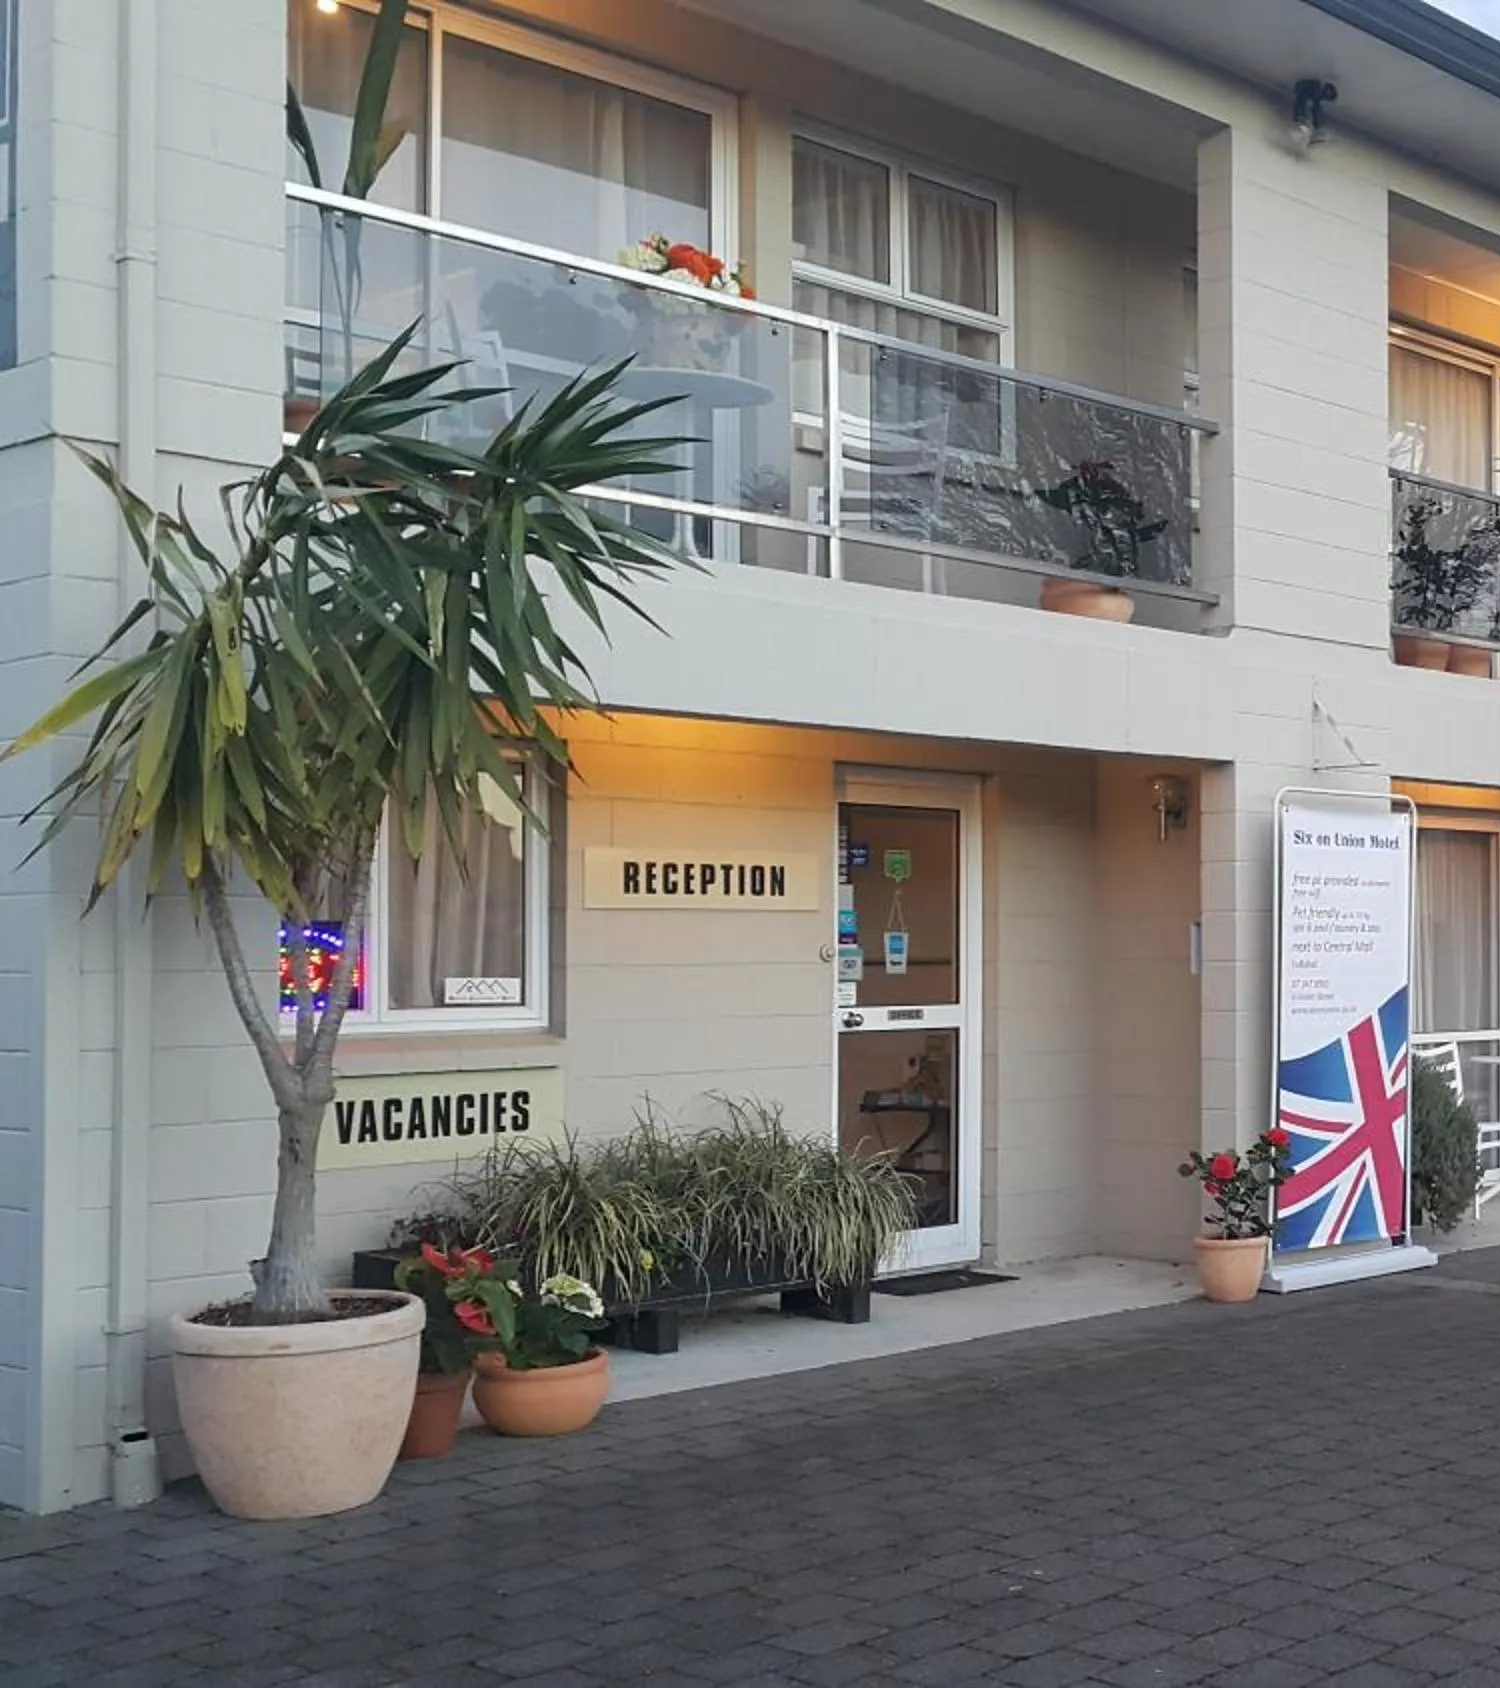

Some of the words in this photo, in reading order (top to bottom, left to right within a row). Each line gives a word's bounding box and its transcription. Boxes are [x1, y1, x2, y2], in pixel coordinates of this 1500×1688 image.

[1293, 830, 1313, 845] Six
[1316, 834, 1331, 846] on
[1335, 832, 1365, 848] Union
[1370, 834, 1400, 849] Motel
[623, 861, 786, 897] RECEPTION
[335, 1089, 531, 1145] VACANCIES
